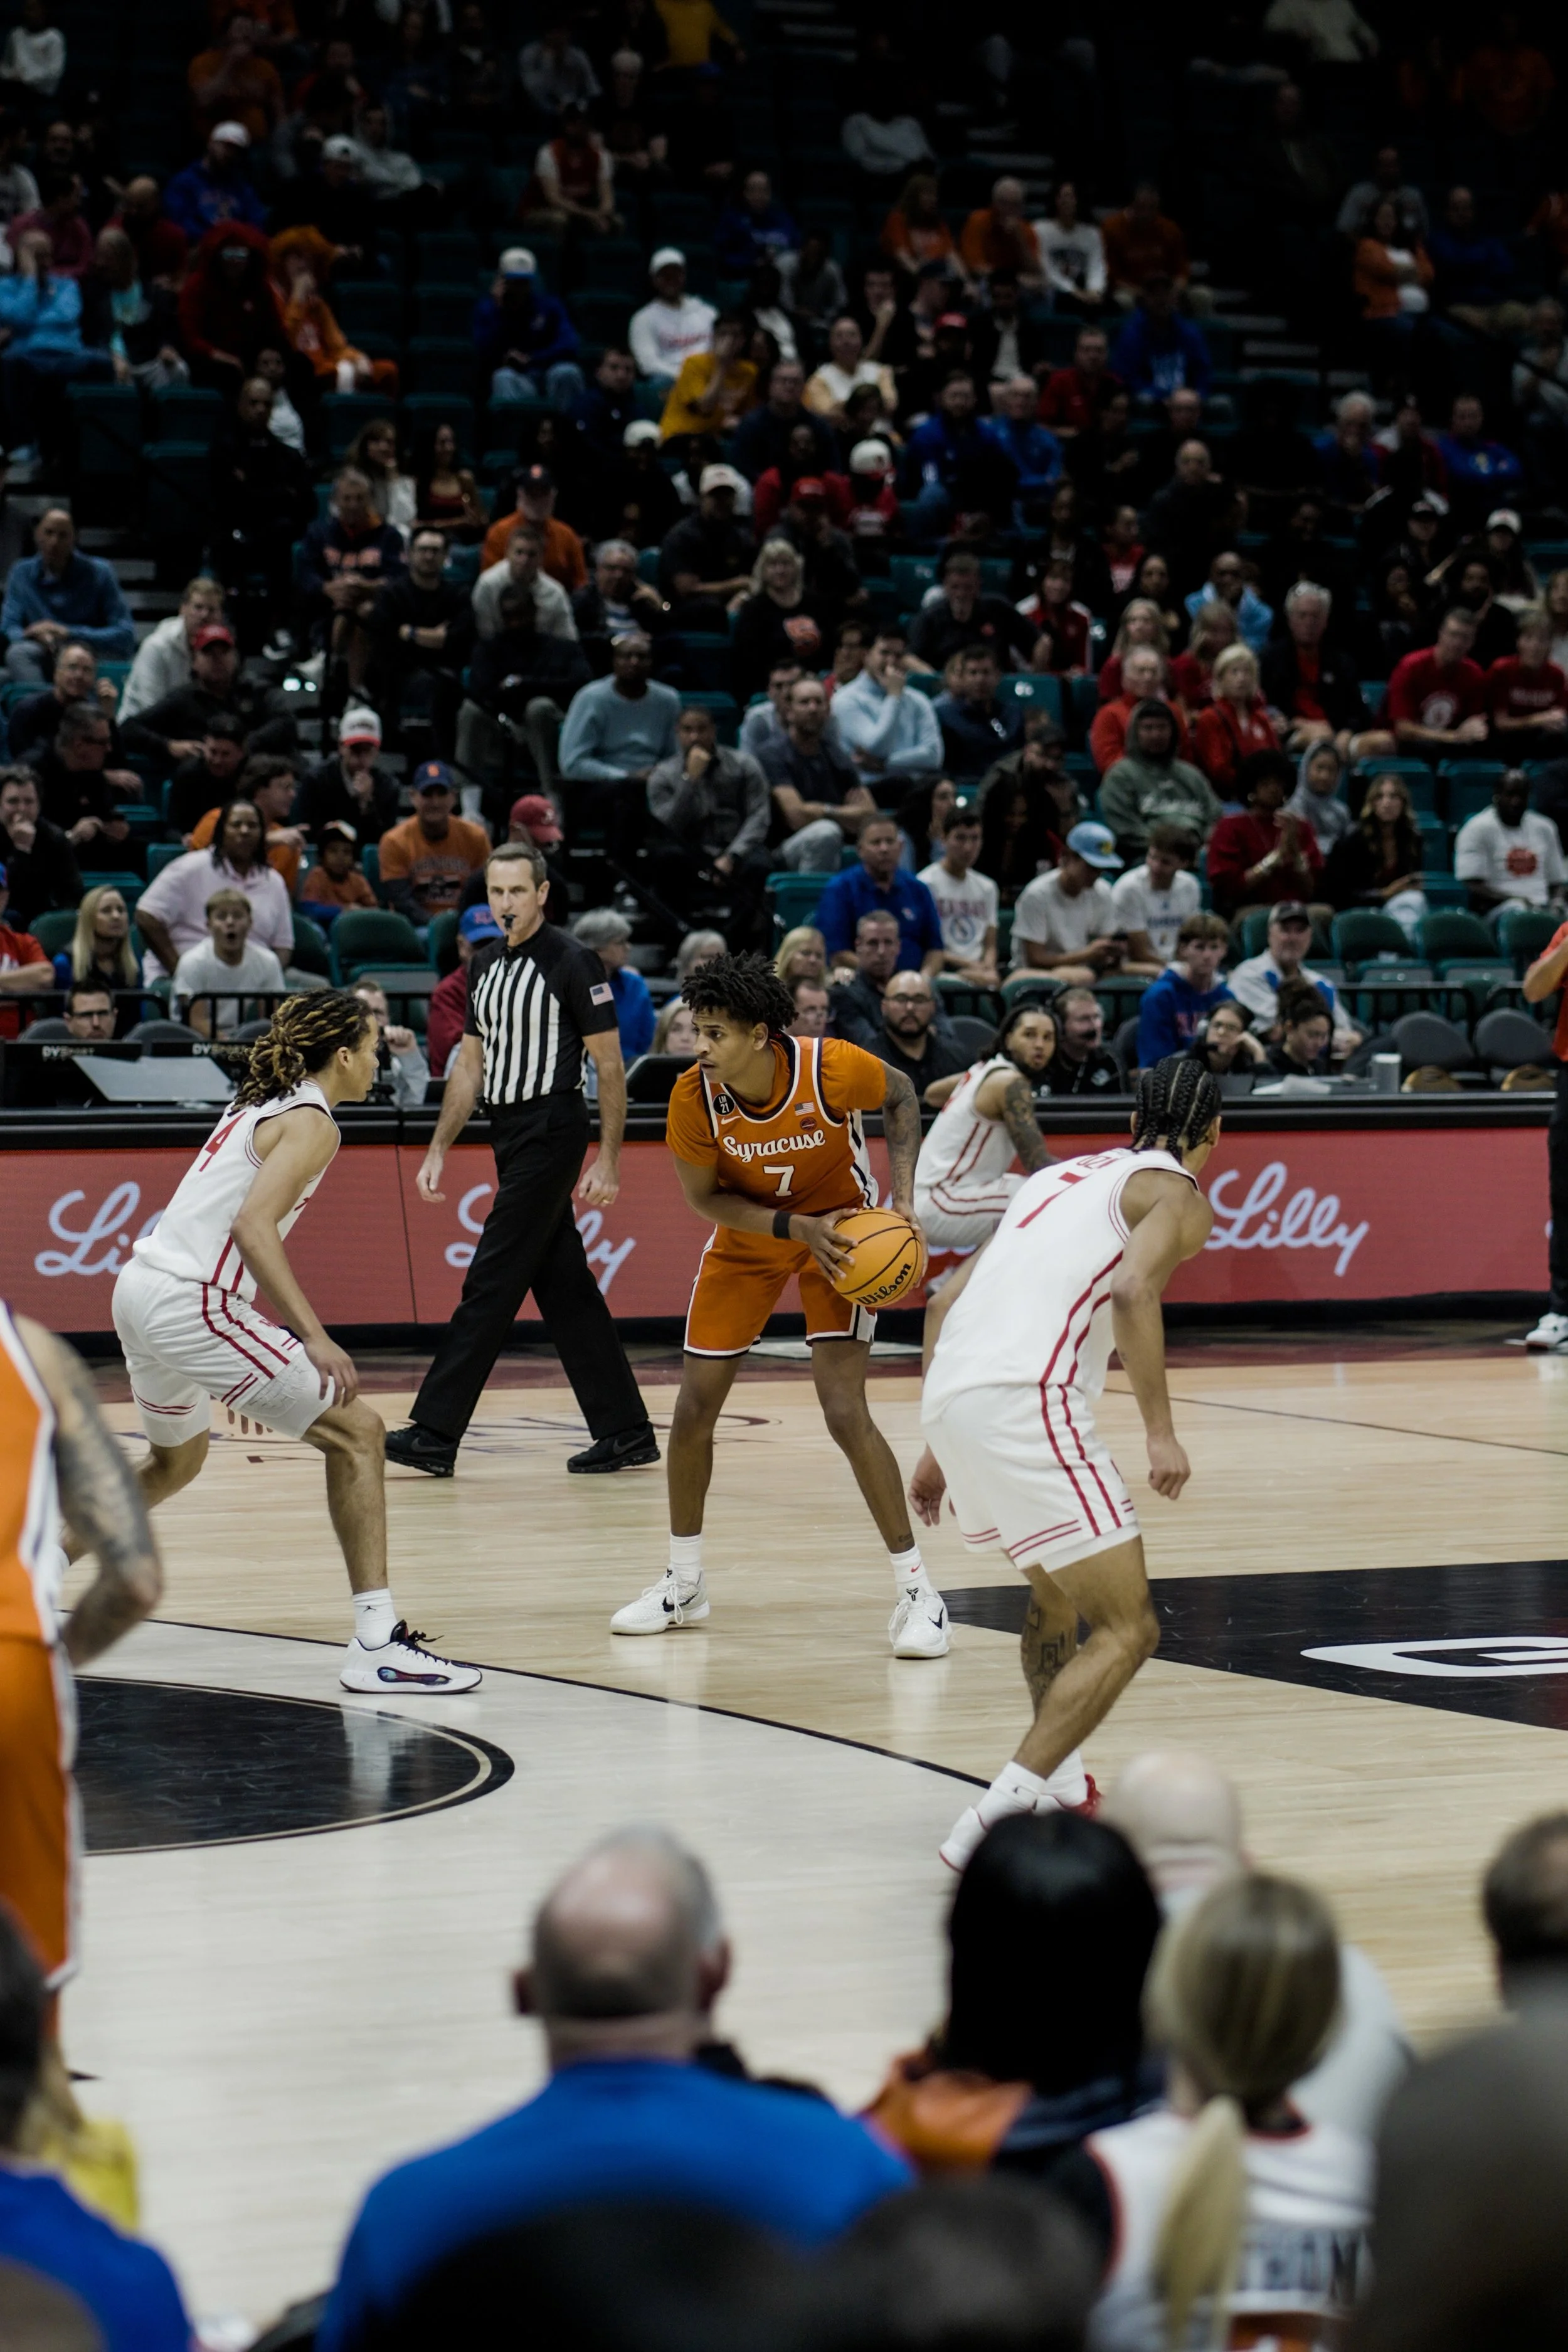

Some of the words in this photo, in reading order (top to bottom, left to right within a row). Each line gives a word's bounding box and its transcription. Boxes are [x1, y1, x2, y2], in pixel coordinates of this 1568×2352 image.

[718, 1094, 727, 1104] LM
[719, 1103, 730, 1113] 21
[199, 1111, 246, 1172] 4
[723, 1129, 826, 1163] Syracuse
[763, 1164, 795, 1197] 7
[1202, 1161, 1370, 1278] Lilly
[855, 1263, 912, 1305] Wilson
